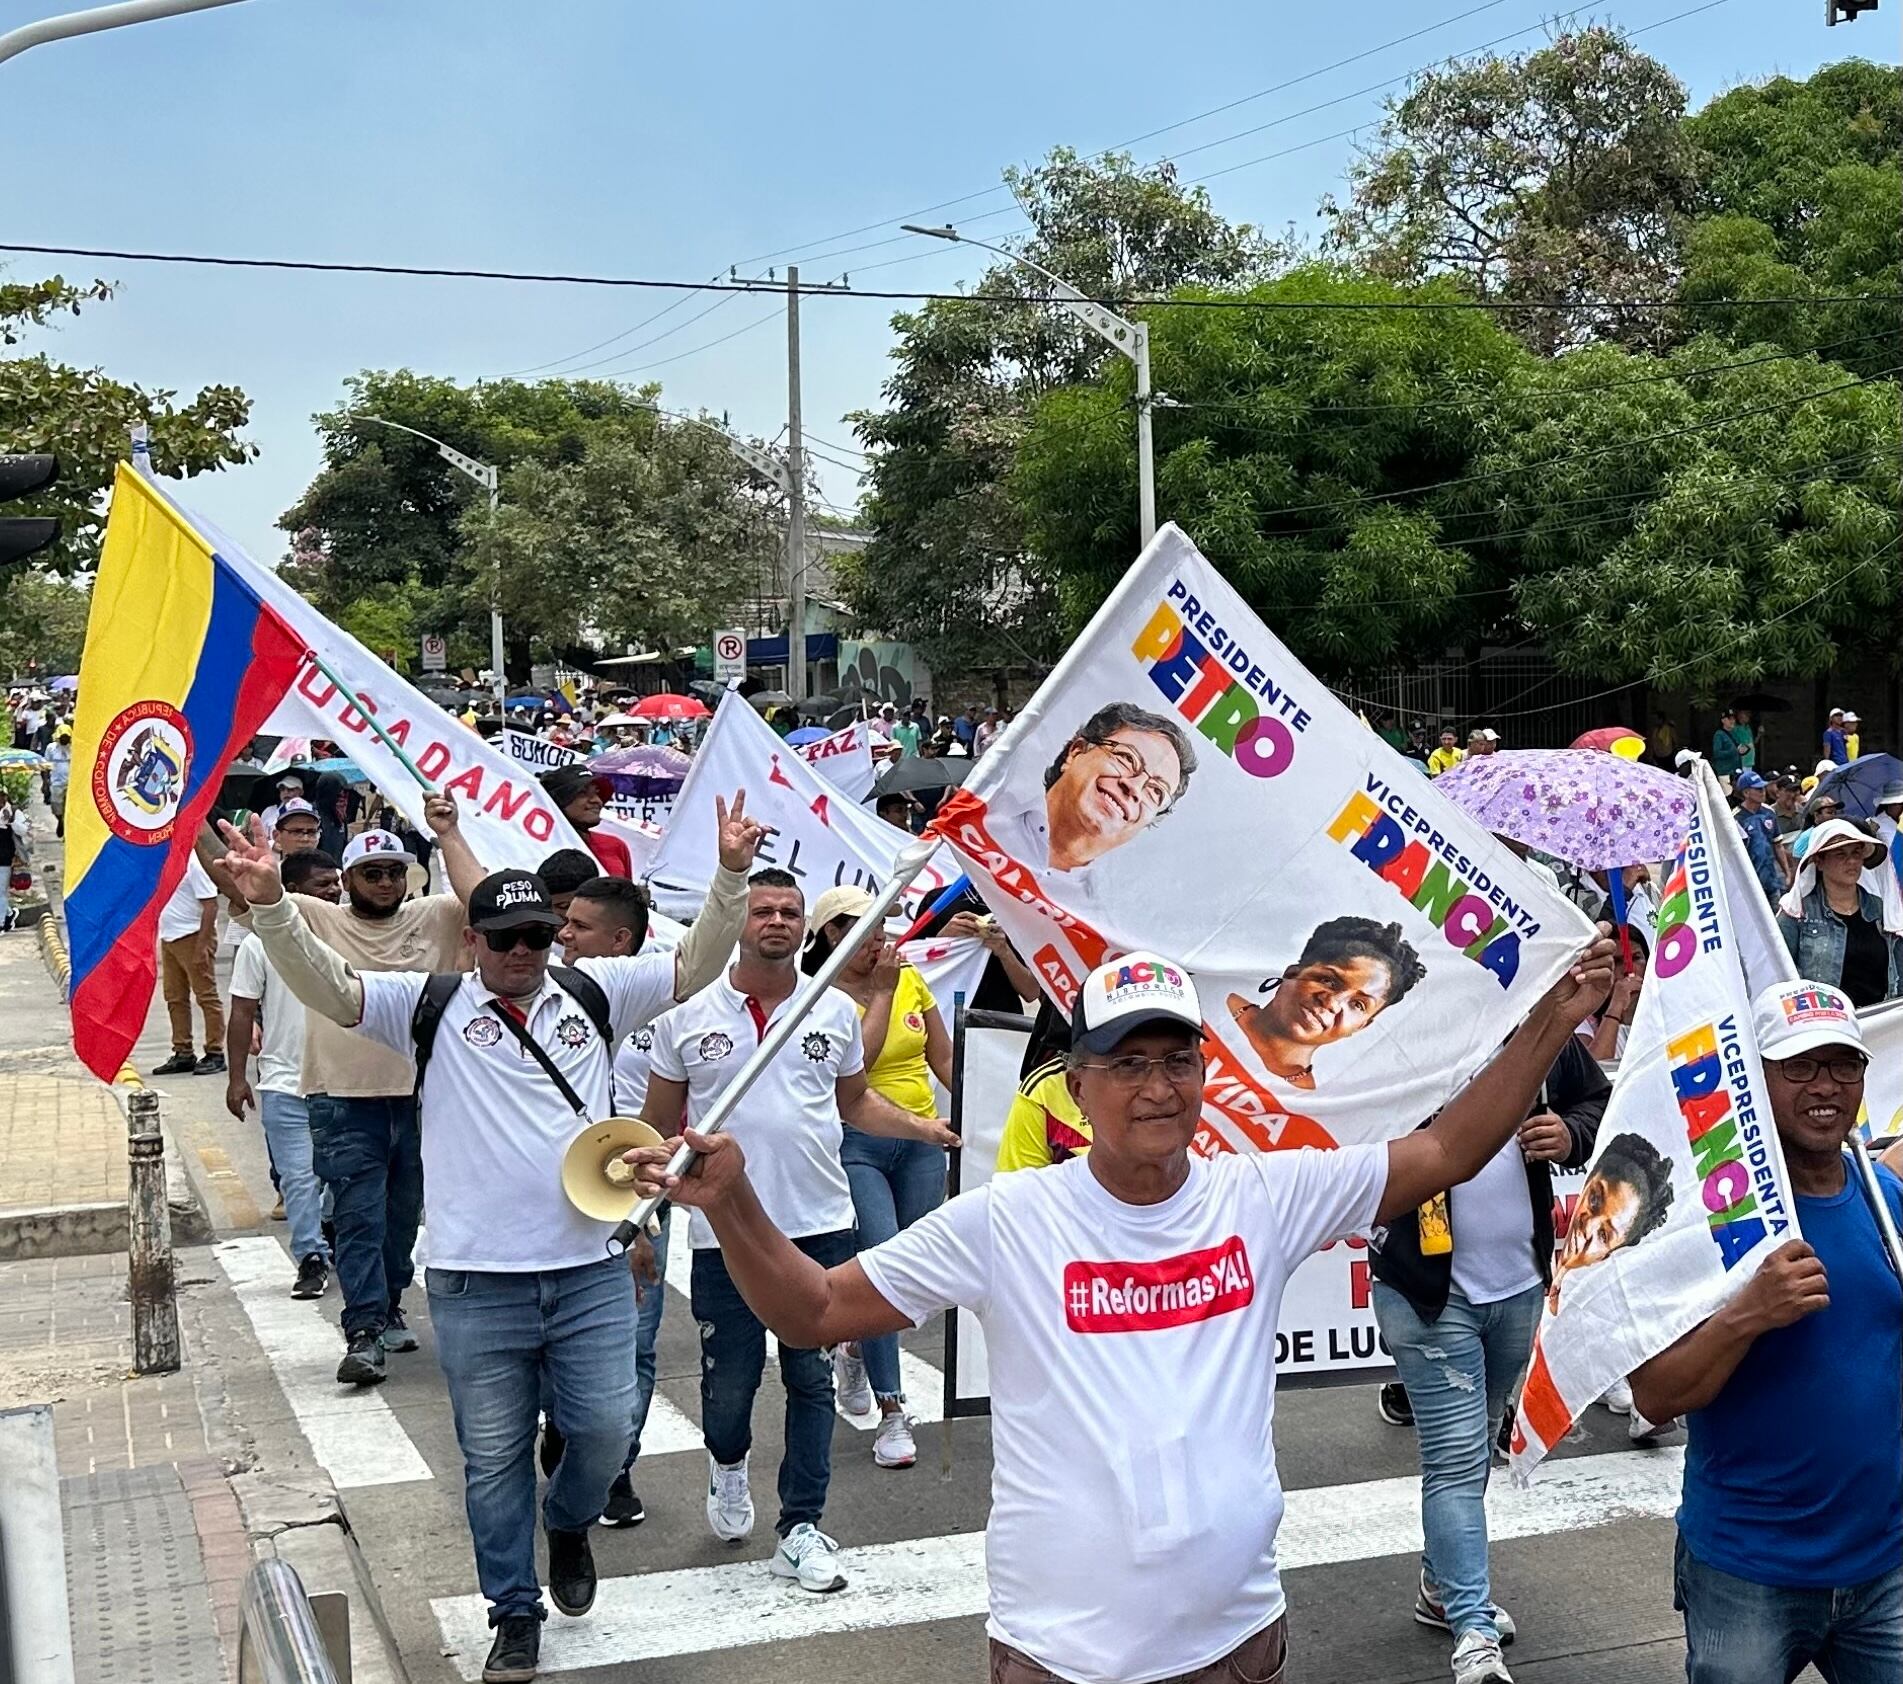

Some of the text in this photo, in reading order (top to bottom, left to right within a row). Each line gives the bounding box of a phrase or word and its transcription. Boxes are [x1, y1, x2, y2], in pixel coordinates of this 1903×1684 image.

[1131, 599, 1294, 778] PETRO
[1167, 579, 1311, 733] PRESIDENTE
[806, 729, 857, 761] PAZ
[502, 880, 533, 894] PESO
[1325, 790, 1521, 991] FRANCIA
[1365, 772, 1541, 939] VICEPRESIDENTA
[1782, 991, 1844, 1015] PETRO
[1666, 1022, 1768, 1273] FRANCIA
[1718, 1014, 1788, 1236] VICEPRESIDENTA
[1069, 1250, 1250, 1318] #ReformasYA!
